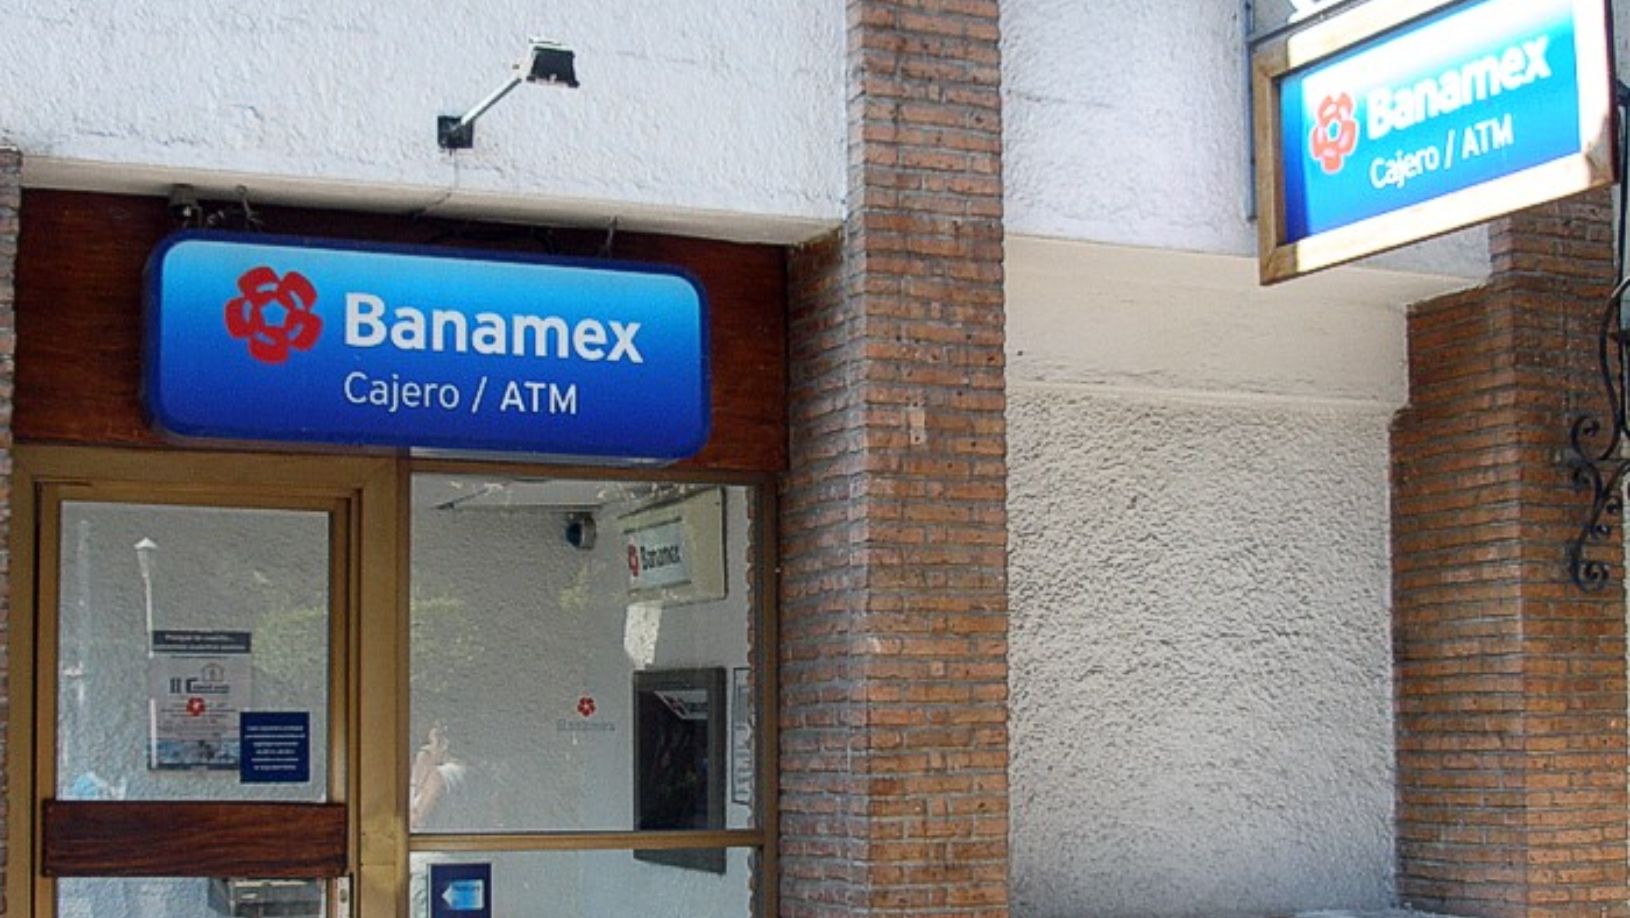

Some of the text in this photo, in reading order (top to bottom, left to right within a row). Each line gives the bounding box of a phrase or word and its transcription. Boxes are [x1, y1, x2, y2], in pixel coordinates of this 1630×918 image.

[1367, 35, 1551, 139] Banamex
[1370, 113, 1514, 189] Cajero / ATM
[345, 292, 643, 363] Banamex
[344, 372, 576, 414] Cajero / ATM
